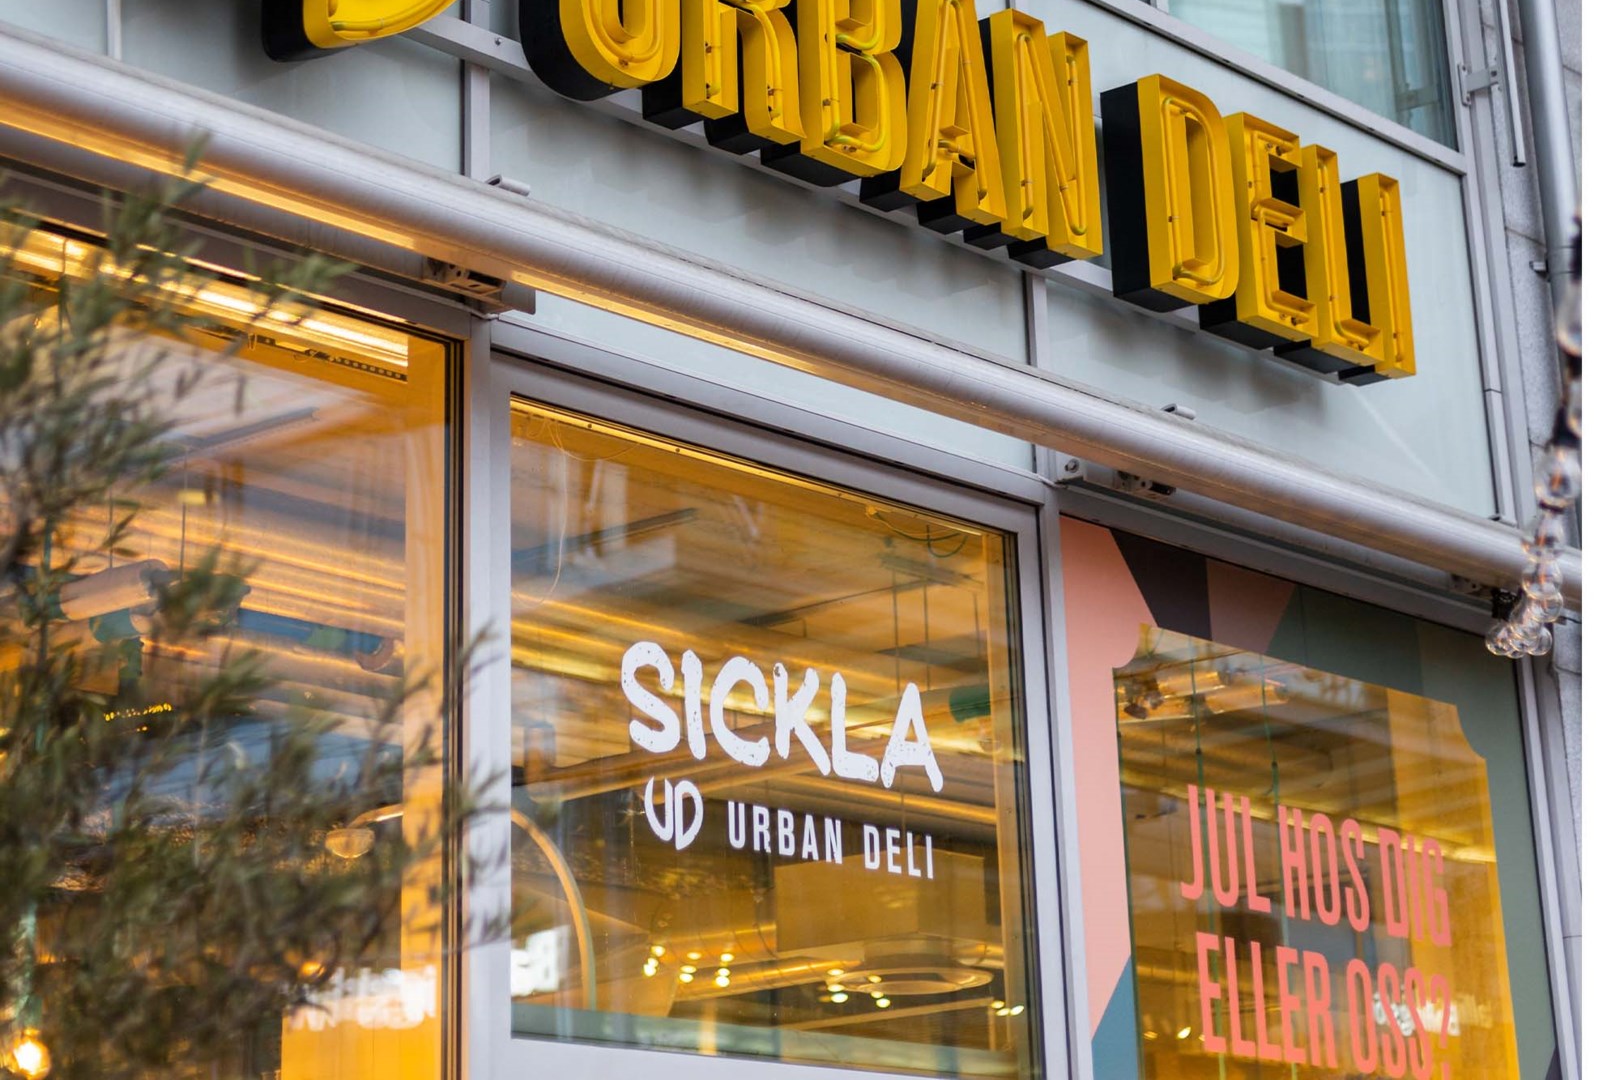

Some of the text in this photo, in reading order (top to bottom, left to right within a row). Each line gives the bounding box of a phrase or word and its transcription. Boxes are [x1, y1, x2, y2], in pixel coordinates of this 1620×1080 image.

[1101, 74, 1417, 387] DELI
[621, 640, 944, 793] SICKLA
[644, 776, 935, 880] UD URBAN DELI
[1180, 783, 1452, 948] JUL HOS DIG
[1195, 931, 1451, 1080] ELLER OSS?
